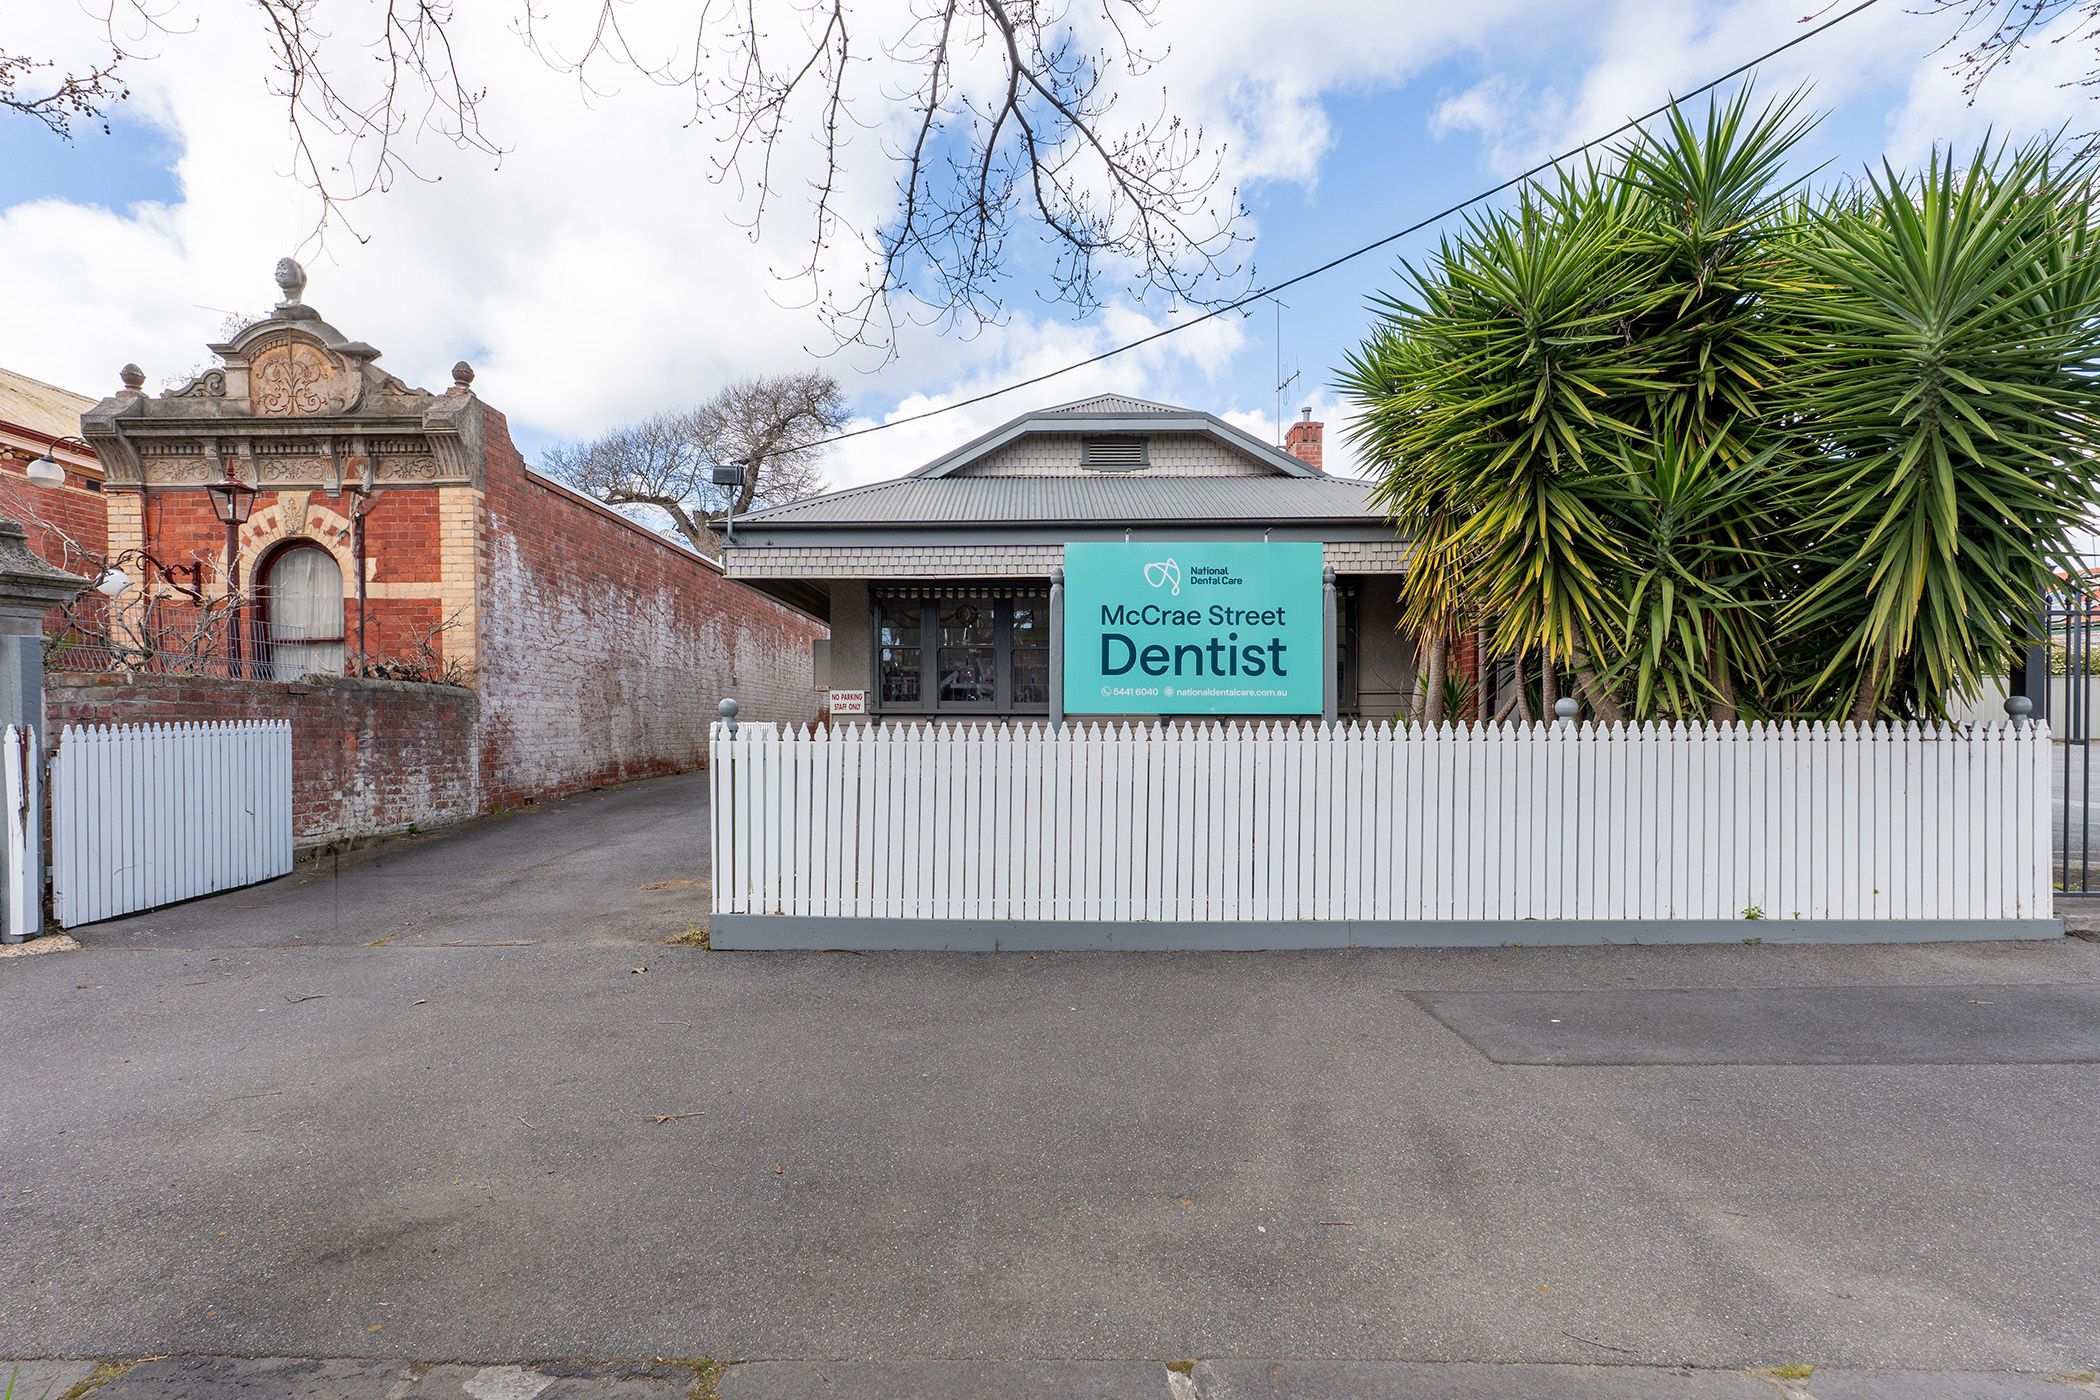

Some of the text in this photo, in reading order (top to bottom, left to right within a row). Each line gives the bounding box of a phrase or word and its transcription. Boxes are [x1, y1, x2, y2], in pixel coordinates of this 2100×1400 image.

[1190, 566, 1229, 575] National
[1101, 604, 1286, 626] McCrae Street
[1101, 632, 1288, 677] Dentist
[1113, 687, 1288, 697] 5441 6040 nationaldentalcare.com.au
[831, 693, 863, 701] NO PARKING
[834, 703, 861, 711] STAFF ONLY
